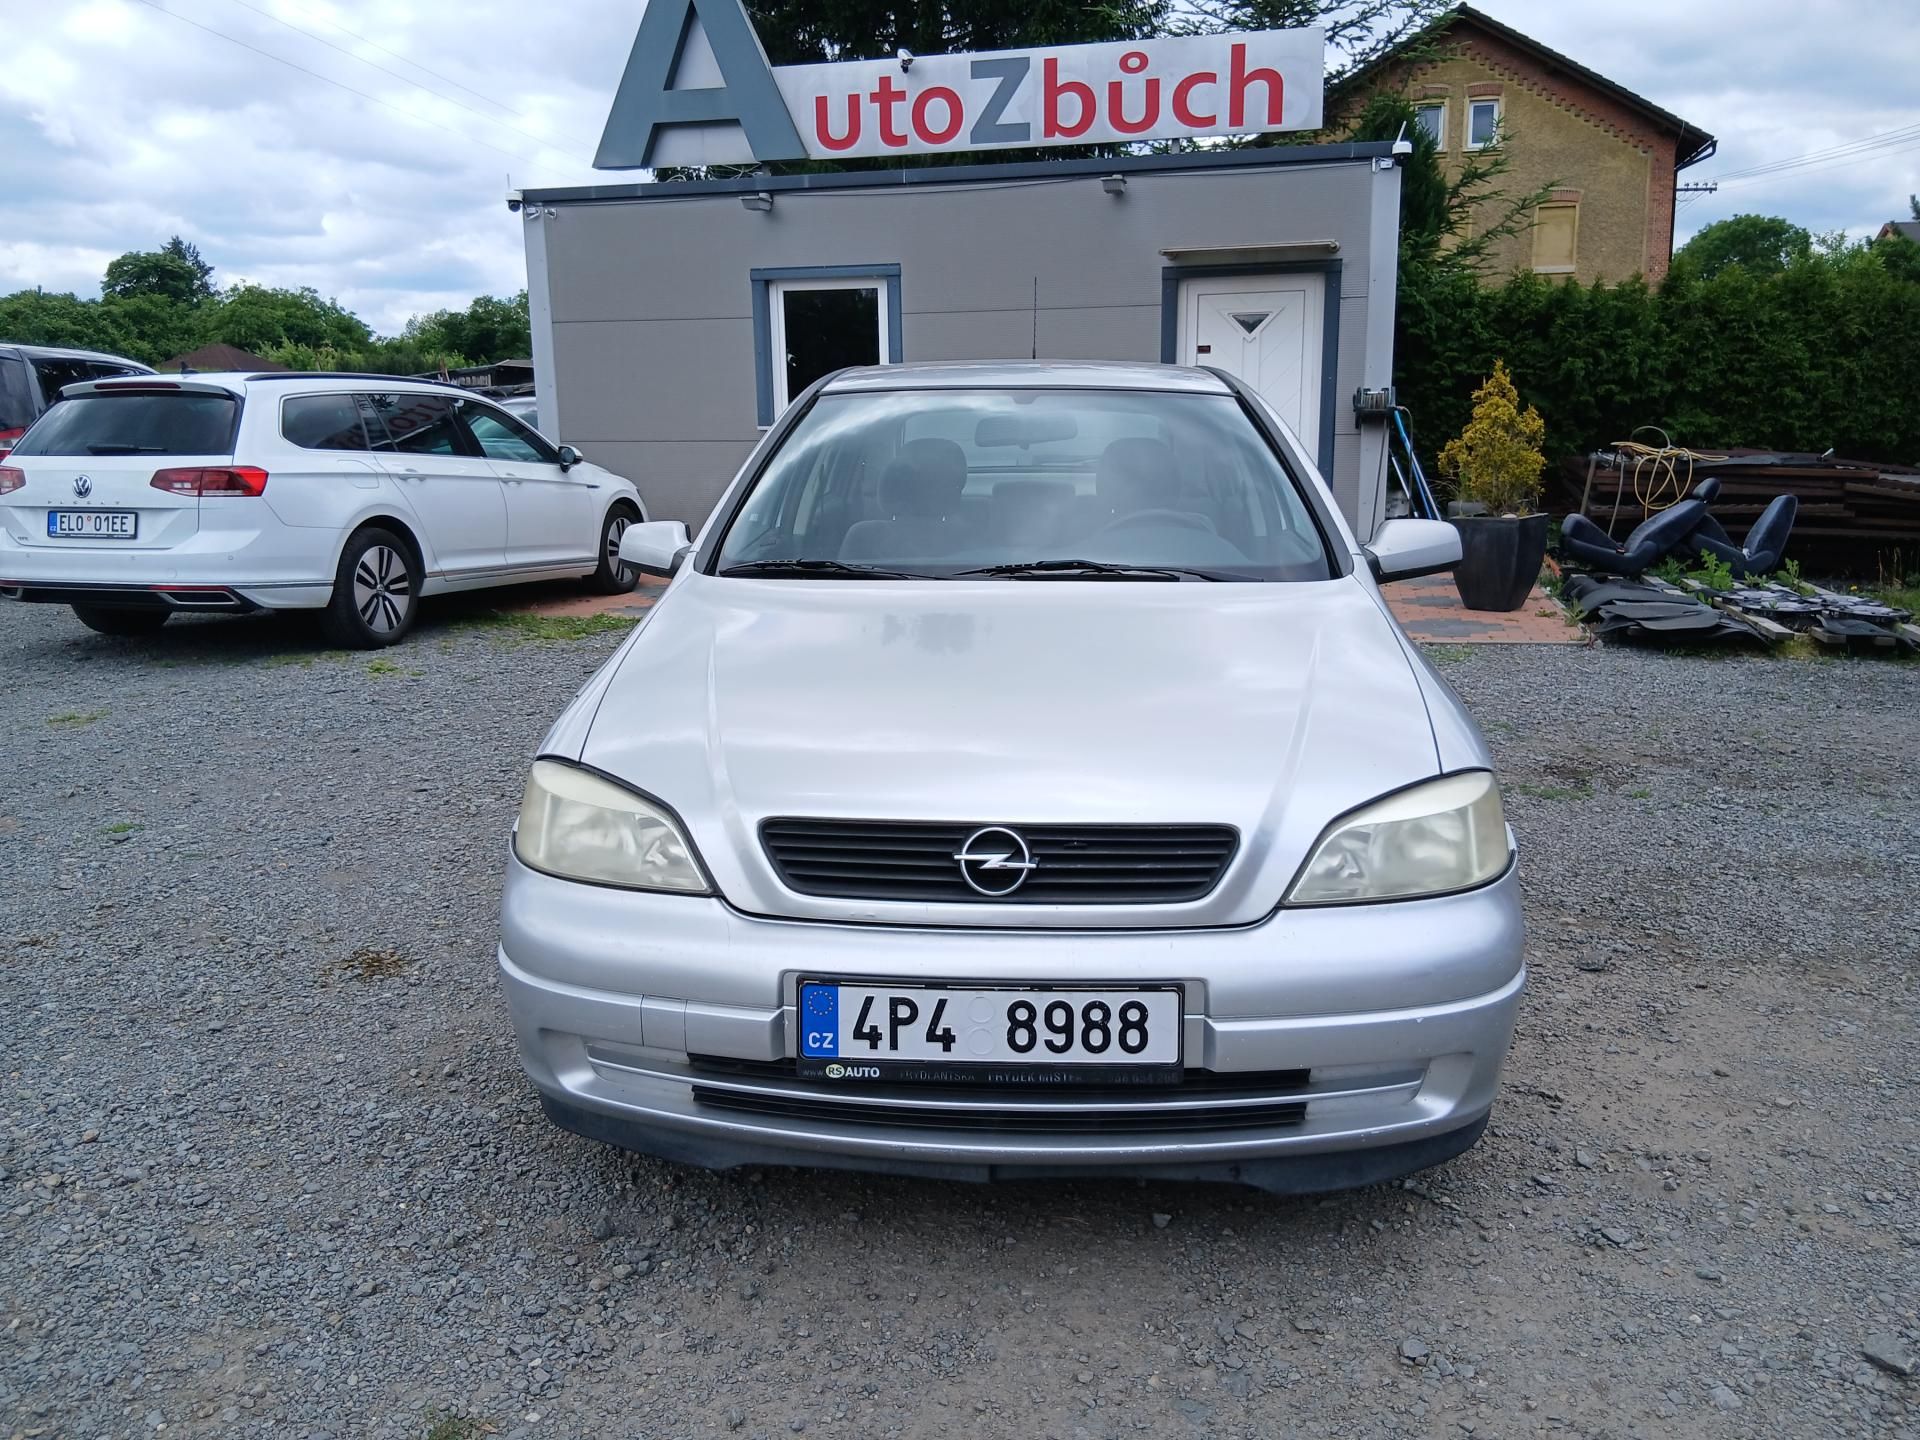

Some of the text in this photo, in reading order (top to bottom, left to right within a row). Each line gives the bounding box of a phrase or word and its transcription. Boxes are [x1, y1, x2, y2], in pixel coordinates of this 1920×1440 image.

[808, 1032, 834, 1049] CZ
[852, 996, 1149, 1054] 4P4 8988
